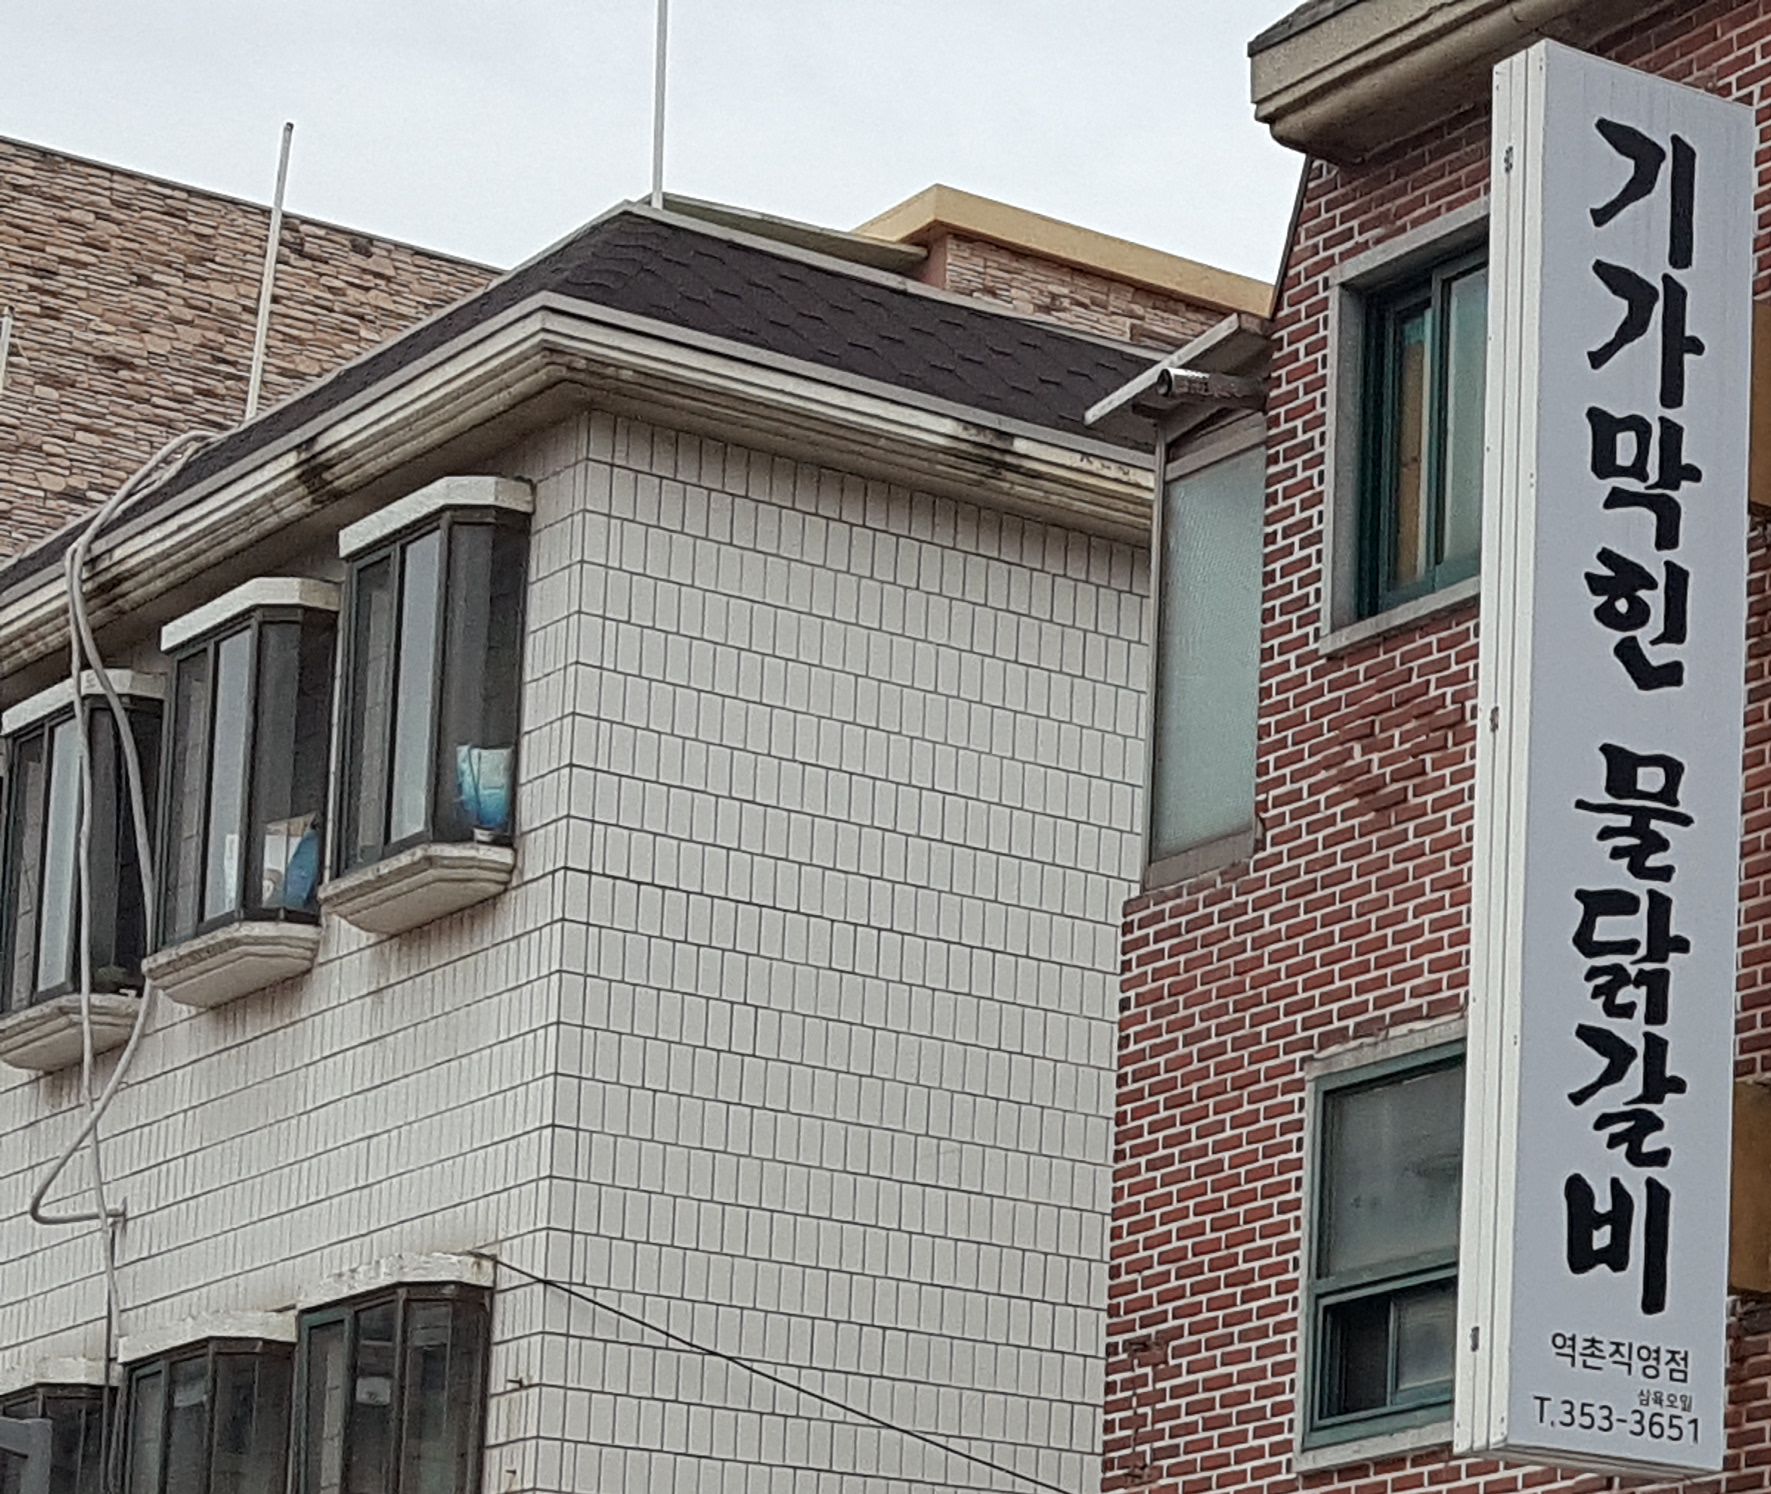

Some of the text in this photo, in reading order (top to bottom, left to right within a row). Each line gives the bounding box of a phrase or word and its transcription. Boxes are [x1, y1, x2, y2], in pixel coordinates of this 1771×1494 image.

[1564, 117, 1706, 1315] 기가막힌 물닭갈비
[1552, 1332, 1688, 1383] 역촌직영점
[1533, 1395, 1699, 1443] T.353-3651
[1638, 1389, 1693, 1413] 삼육오일
